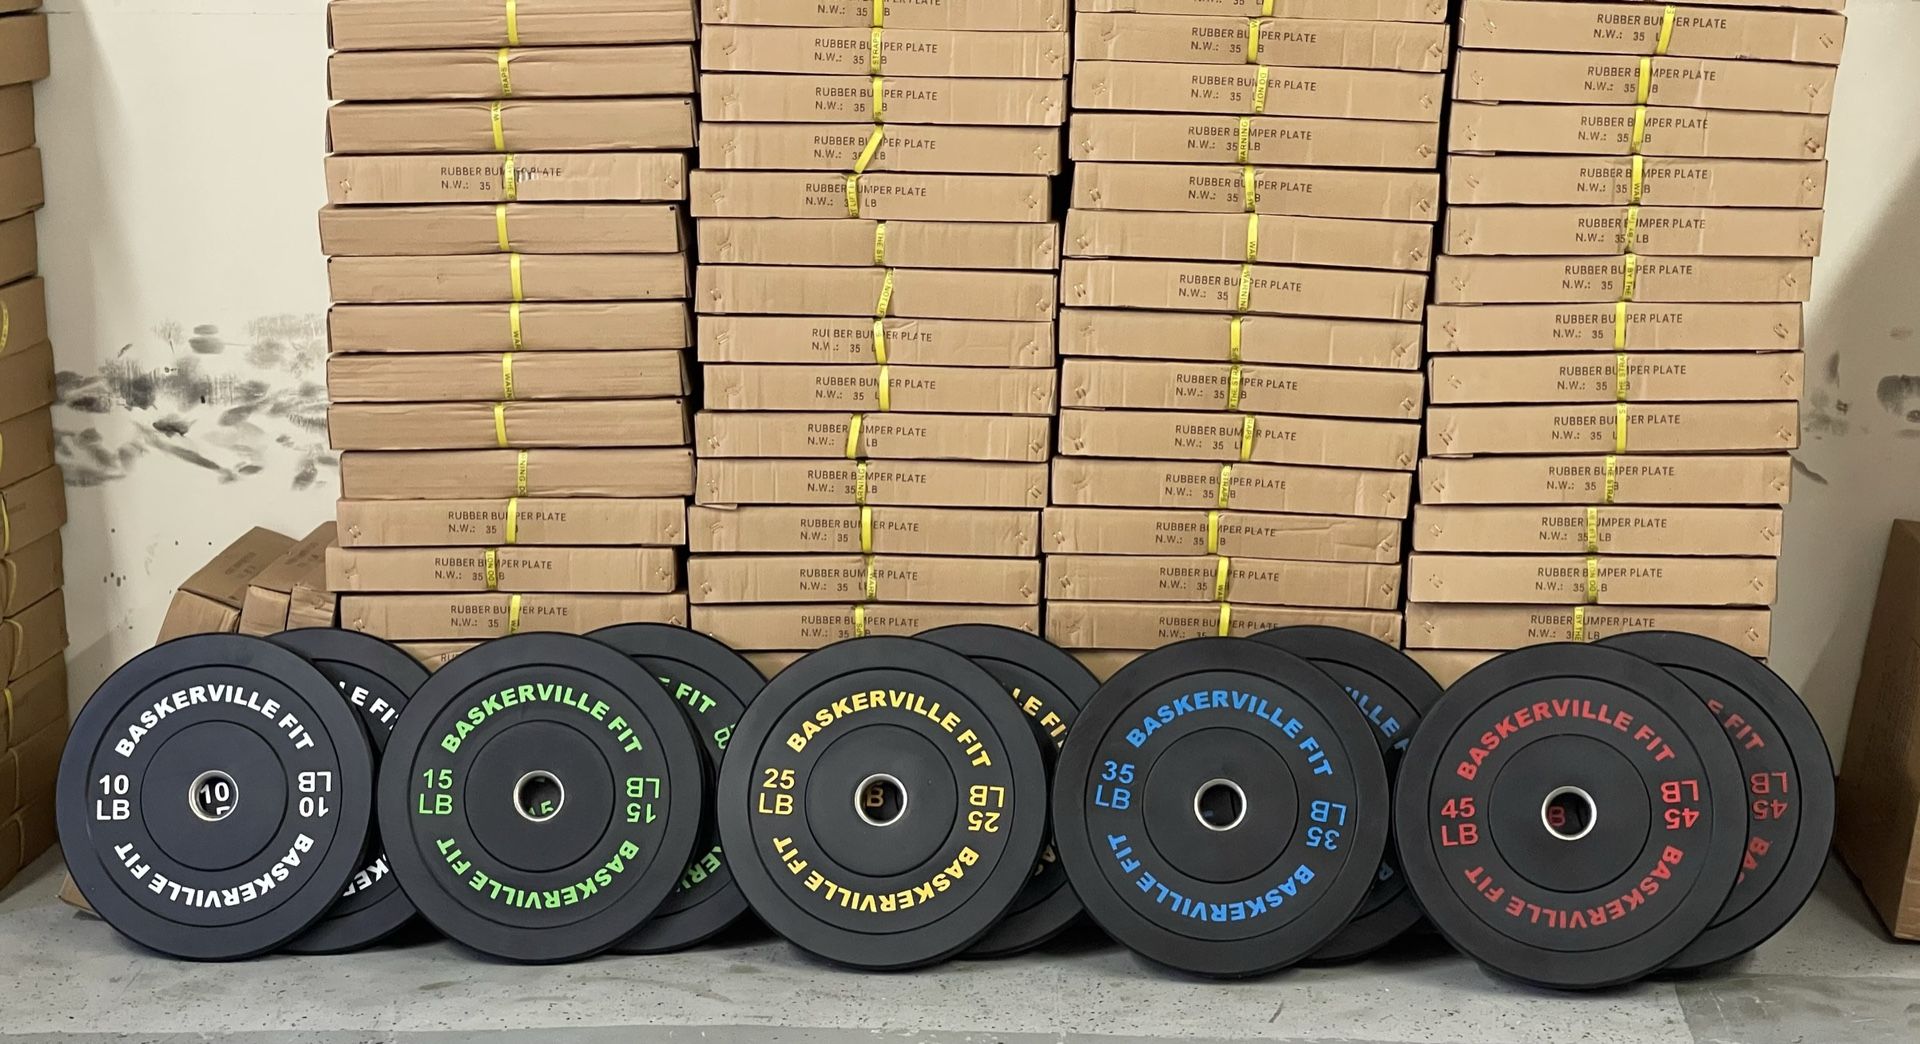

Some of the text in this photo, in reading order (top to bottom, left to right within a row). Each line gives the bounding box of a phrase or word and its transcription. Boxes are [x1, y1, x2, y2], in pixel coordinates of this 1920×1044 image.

[1597, 14, 1726, 29] RUBBER PLATE
[1192, 27, 1316, 43] RUBBER PLATE
[1594, 29, 1644, 41] N.W.: 35
[815, 39, 937, 53] RUBBER PLATE
[815, 53, 864, 64] N.W.: 35
[1588, 66, 1716, 80] RUBBER PLATE
[1192, 76, 1316, 91] RUBBER PLATE
[815, 88, 937, 100] RUBBER PLATE
[1581, 117, 1708, 129] RUBBER PLATE
[1189, 126, 1312, 140] RUBBER PLATE
[814, 136, 936, 149] RUBBER PLATE
[441, 167, 481, 176] RUBBER
[1580, 168, 1707, 179] RUBBER PLATE
[806, 184, 926, 197] RUBBER PLATE
[1190, 177, 1312, 193] RUBBER PLATE
[865, 199, 876, 207] LB
[1189, 191, 1238, 202] N.W.: 35
[1578, 219, 1705, 229] RUBBER PLATE
[1637, 235, 1648, 243] LB
[1565, 265, 1692, 275] RUBBER PLATE
[1180, 275, 1302, 291] RUBBER PLATE
[1556, 314, 1682, 324] RUBBER BUPER PLATE
[1553, 329, 1603, 338] N.W.: 35
[1560, 365, 1686, 375] RUBBER PLATE
[816, 377, 935, 389] RUBBER PLATE
[1176, 374, 1297, 390] RUBBER PLATE
[816, 390, 864, 400] N.W.: 35
[1554, 415, 1680, 425] RUBBER PLATE
[808, 424, 926, 437] RUBBER PLATE
[1176, 425, 1296, 440] RUBBER PLATE
[867, 439, 877, 447] LB
[808, 470, 926, 483] RUBBER BMPER PLATE
[1549, 467, 1674, 475] RUBBER PLATE
[1166, 474, 1286, 489] RUBBER PLATE
[449, 512, 566, 521] RUBBER BUPER PLATE
[1542, 518, 1667, 528] RUBBER PLATE
[449, 524, 496, 534] N.W.: 35
[801, 519, 919, 532] RUBBER PLATE
[1156, 522, 1275, 537] RUBBER PLATE
[1600, 533, 1611, 541] LB
[435, 558, 552, 569] RUBBER PLATE
[435, 571, 483, 581] N.W.: 35
[800, 569, 918, 580] RUBBER PLATE
[1160, 568, 1279, 581] RUBBER PLATE
[1538, 568, 1662, 577] RUBBER BMPER PLATE
[1160, 580, 1207, 591] N.W.: 35
[451, 606, 567, 616] RUBBER PLATE
[451, 619, 477, 627] N.W.:
[802, 616, 919, 627] RUBBER PLATE
[1159, 617, 1199, 627] RUBBER
[1531, 616, 1655, 627] RUBBER PLATE
[675, 683, 716, 714] FIT
[115, 684, 280, 757] BASKERVILLE
[279, 713, 314, 750] FIT
[441, 683, 643, 753] BASKERVILLE FIT
[786, 689, 961, 752] BASKERVILLE
[957, 729, 992, 768] FIT
[1126, 690, 1303, 748] BASKERVILLE
[1299, 736, 1333, 777] FIT
[1724, 713, 1765, 750] FIT
[1457, 699, 1634, 781] BASKERVILLE
[1634, 725, 1675, 762] FIT
[423, 768, 453, 789] 15
[763, 768, 795, 789] 25
[1102, 760, 1135, 784] 35
[99, 774, 129, 795] 10
[298, 772, 332, 792] LB
[626, 777, 660, 799] LB
[1751, 771, 1788, 794] LB
[201, 782, 229, 803] 10
[969, 785, 1005, 807] LB
[1095, 785, 1130, 810] LB
[1661, 779, 1699, 804] LB
[96, 799, 130, 820] LB
[300, 797, 329, 817] 10
[419, 794, 453, 815] LB
[759, 793, 794, 815] LB
[1441, 798, 1475, 819] 45
[1753, 799, 1788, 820] 45
[627, 803, 657, 824] 15
[1311, 800, 1346, 825] LB
[1665, 808, 1699, 830] 45
[968, 811, 1000, 832] 25
[1306, 827, 1340, 850] 35
[1442, 823, 1478, 846] LB
[436, 838, 472, 875] FIT
[772, 837, 808, 875] FIT
[1107, 833, 1141, 873] FIT
[114, 843, 150, 879] FIT
[148, 834, 314, 908] BASKERVILLE
[469, 840, 639, 909] BASKERVILLE
[804, 846, 980, 912] BASKERVILLE
[1465, 866, 1505, 903] FIT
[1506, 845, 1684, 928] BASKERVILLE
[1136, 865, 1315, 922] BASKERVILLE
